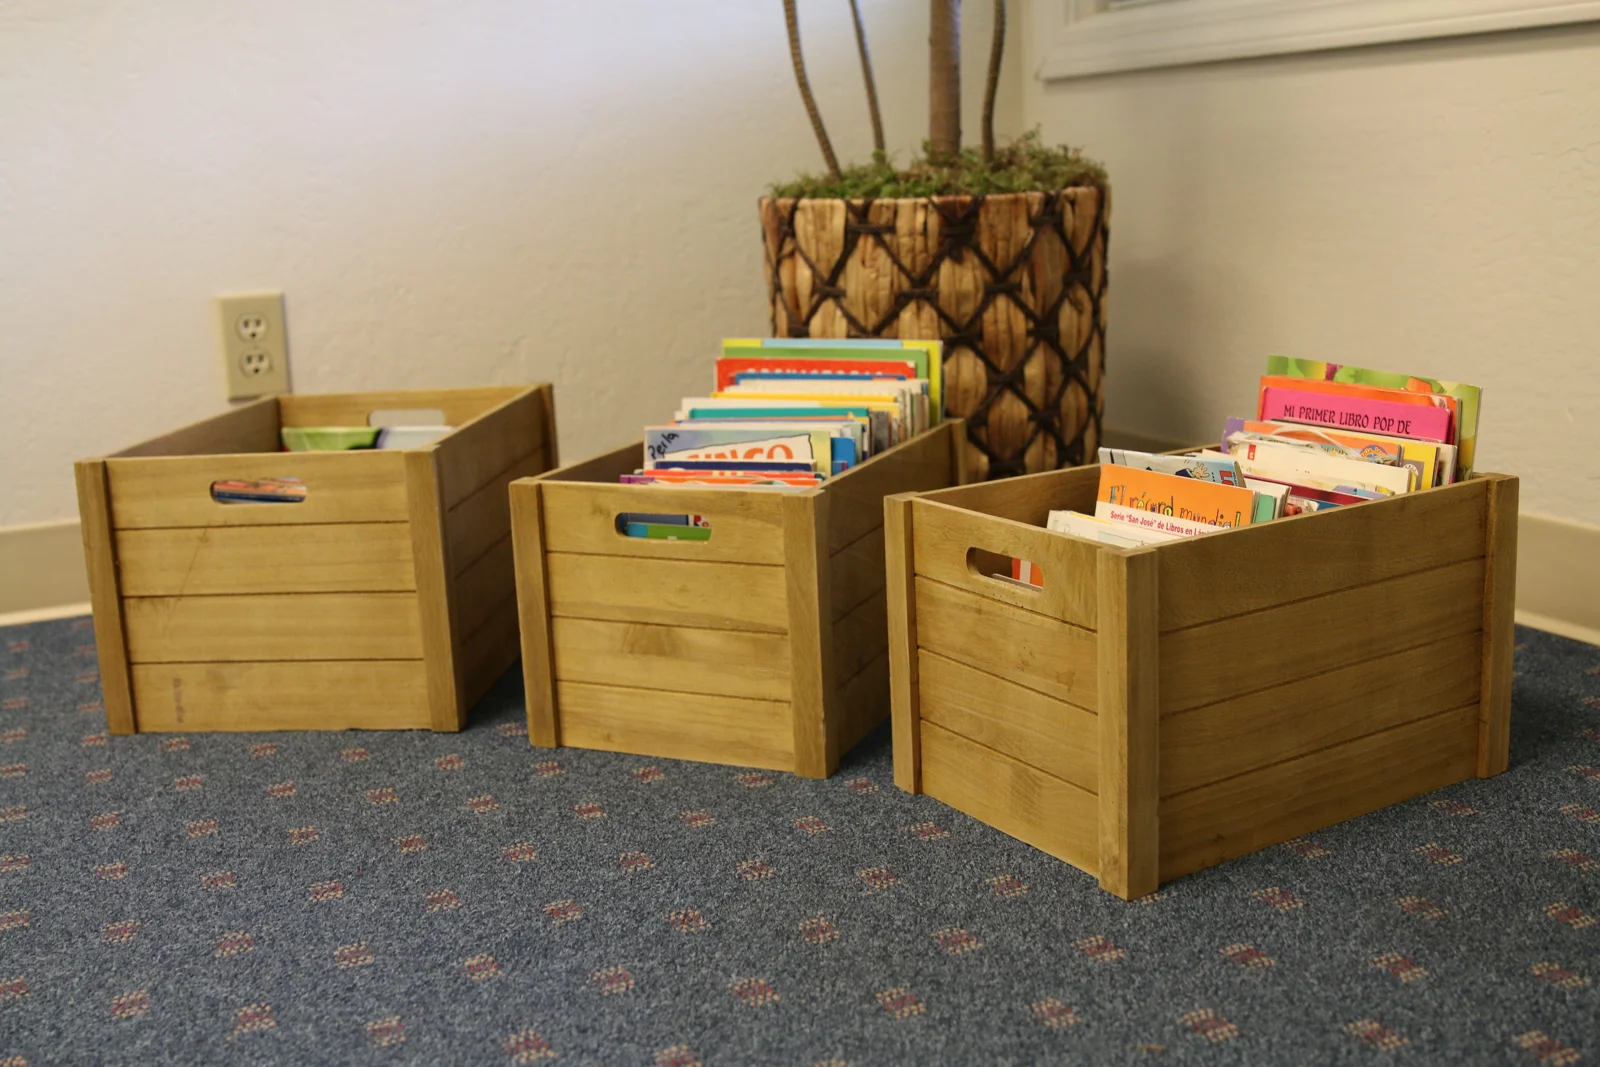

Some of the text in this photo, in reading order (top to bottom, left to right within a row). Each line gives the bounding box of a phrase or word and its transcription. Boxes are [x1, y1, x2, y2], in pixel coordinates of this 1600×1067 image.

[1283, 404, 1412, 434] MI PRIMER LIBRO POP DE
[647, 432, 680, 460] Perla
[1129, 491, 1174, 516] récord
[1110, 510, 1125, 522] Serie
[1157, 521, 1165, 530] de
[1165, 521, 1184, 534] Libros
[1185, 528, 1193, 536] en
